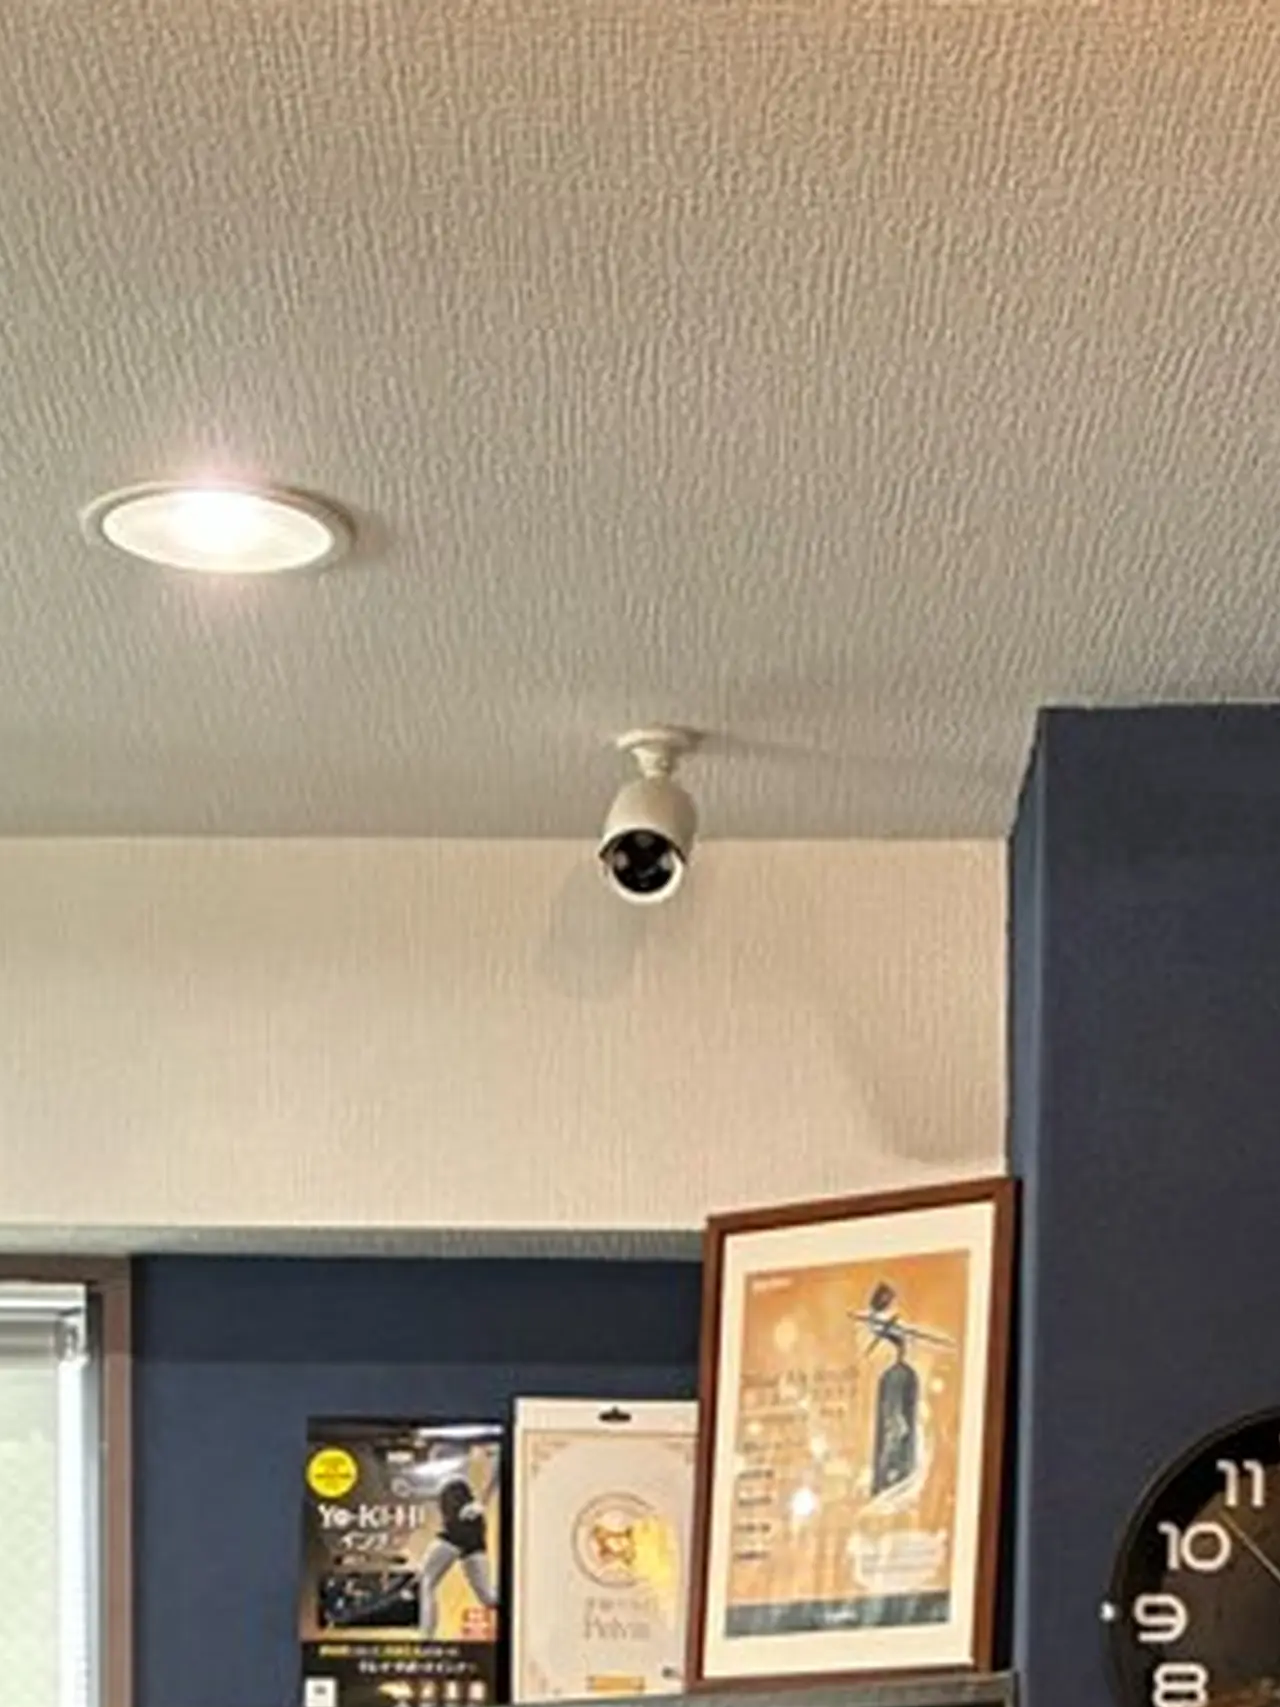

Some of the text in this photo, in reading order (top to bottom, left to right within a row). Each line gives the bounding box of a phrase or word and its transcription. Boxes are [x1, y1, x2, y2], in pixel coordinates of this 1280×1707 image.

[1217, 1460, 1266, 1507] 11
[1157, 1520, 1232, 1572] 10
[1133, 1593, 1188, 1643] 9
